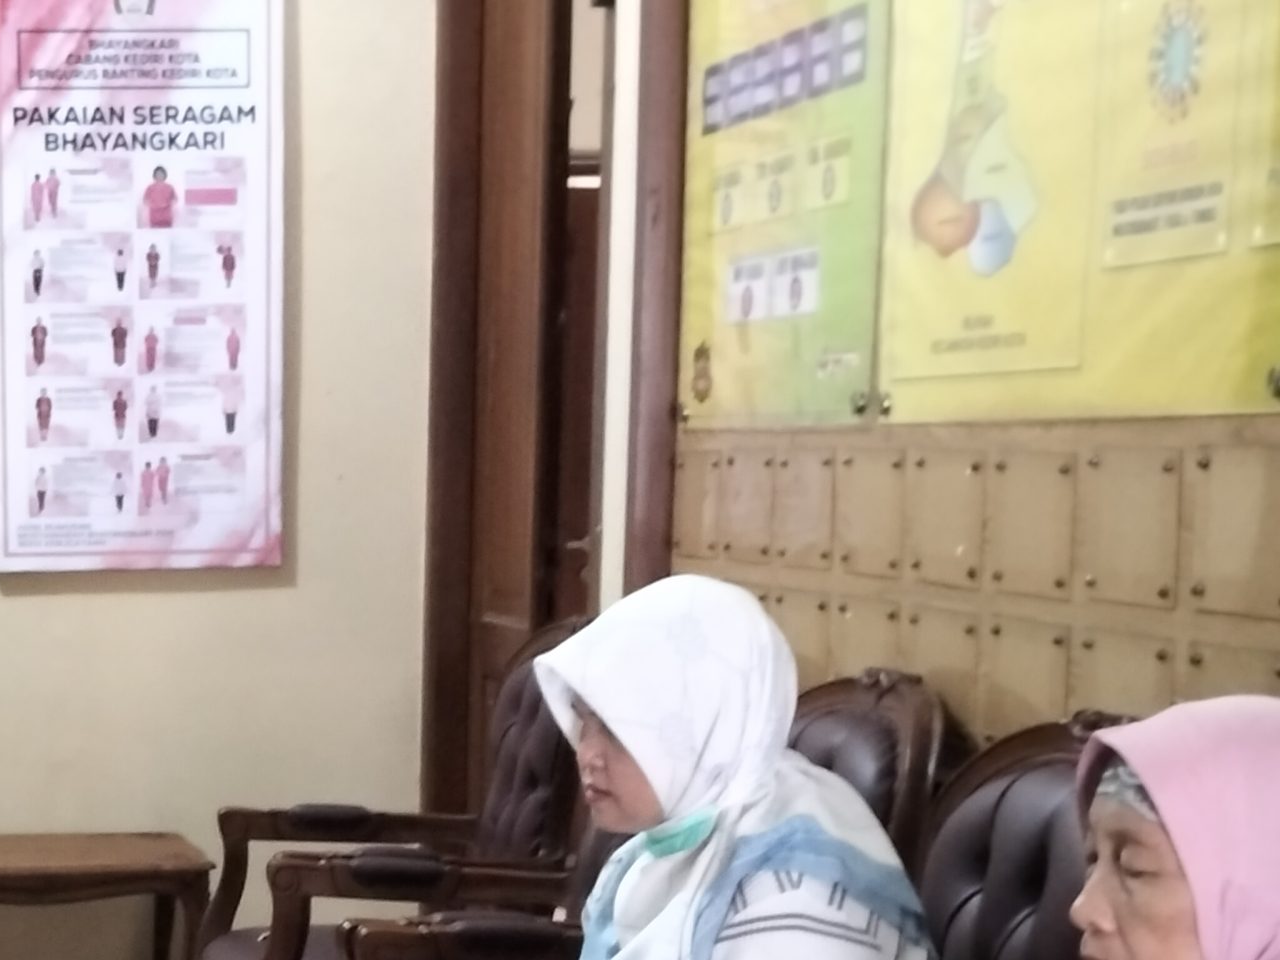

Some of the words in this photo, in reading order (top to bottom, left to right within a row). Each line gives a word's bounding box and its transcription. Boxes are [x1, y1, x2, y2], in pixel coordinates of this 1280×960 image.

[88, 39, 180, 50] BHAYANGKARI
[124, 53, 164, 64] KEDIRI
[168, 53, 201, 64] KOTA
[29, 69, 99, 80] PENGURUS
[162, 68, 202, 79] KEDIRI
[206, 68, 238, 79] KOTA
[13, 106, 125, 126] PAKAIAN
[133, 105, 256, 125] SERAGAM
[44, 131, 225, 152] BHAYANGKARI
